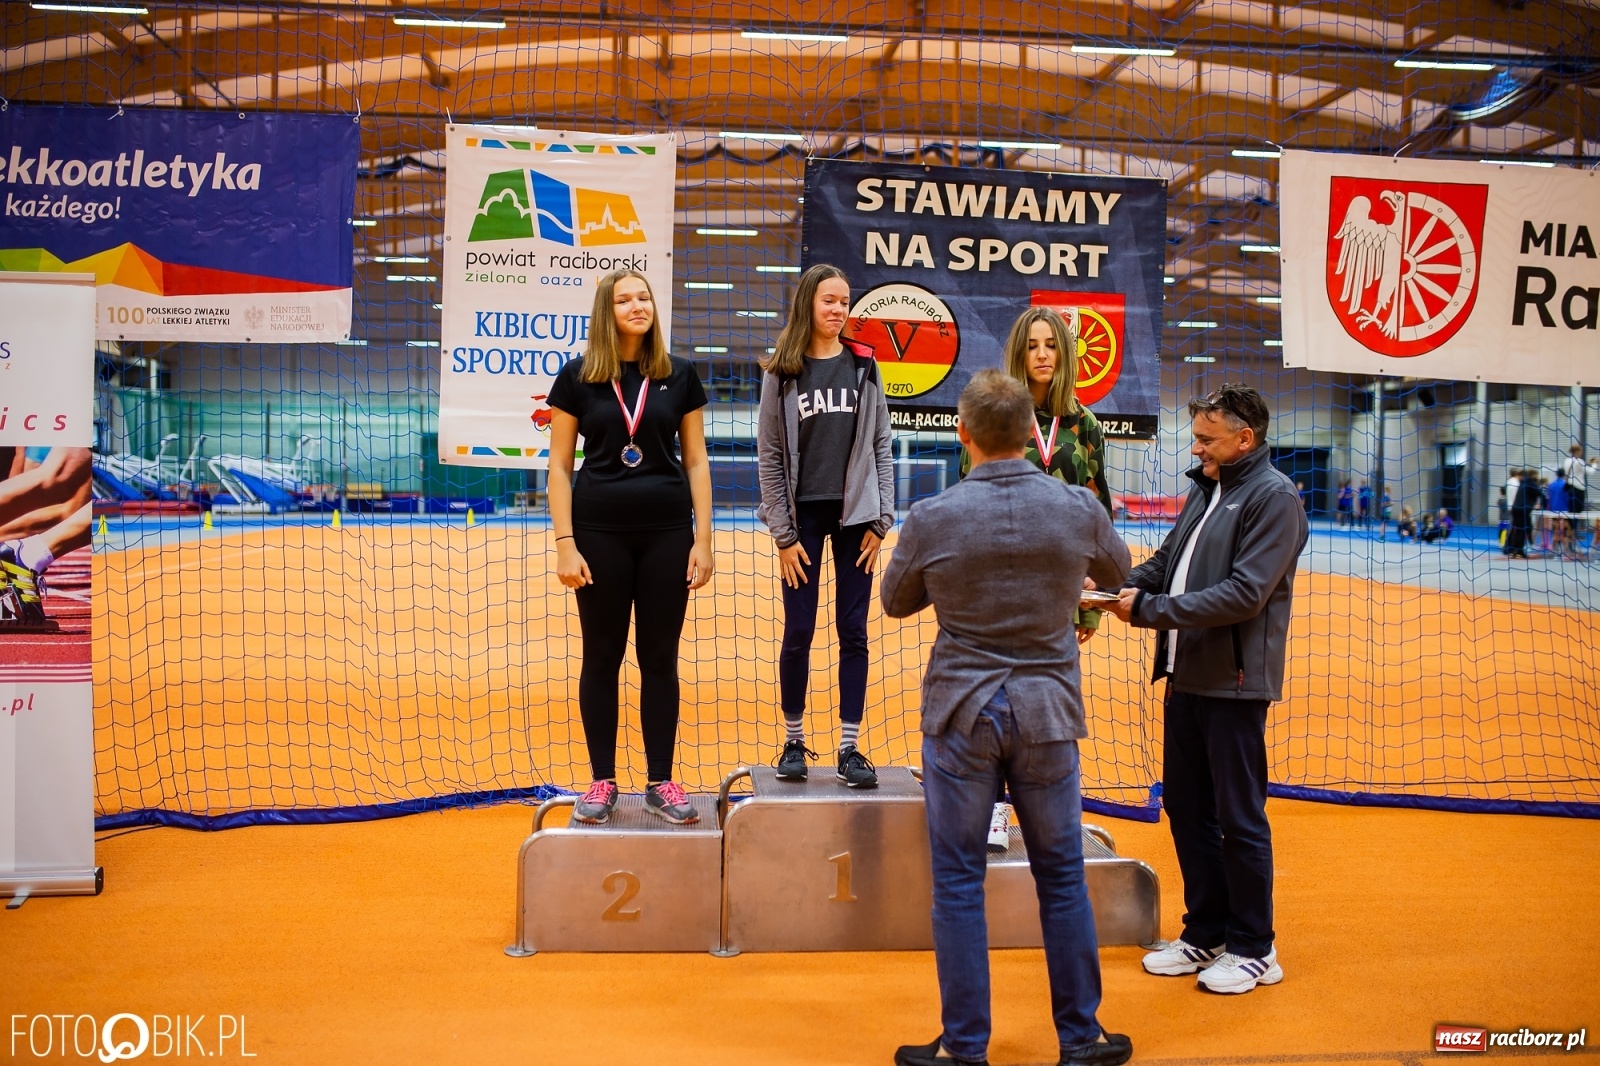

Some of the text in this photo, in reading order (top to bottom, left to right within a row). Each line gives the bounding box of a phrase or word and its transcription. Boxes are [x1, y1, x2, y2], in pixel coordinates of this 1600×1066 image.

[5, 192, 121, 224] każdego!
[855, 178, 1122, 225] STAWIAMY
[1520, 220, 1600, 259] MIA
[465, 248, 648, 271] powiat raciborski
[865, 231, 1109, 278] NA SPORT
[465, 270, 527, 284] zielona
[540, 276, 583, 287] oaza
[107, 306, 145, 324] 100
[146, 307, 230, 317] POLSKIEGO ZWIĄZKU
[270, 305, 311, 314] MINISTER
[270, 315, 312, 323] EDUKACJI
[852, 295, 950, 338] VICTORIA RACIBÓRZ
[146, 317, 230, 326] LAT LEKKIEJ ATLETYKI
[270, 323, 325, 331] NARODOWEJ
[881, 320, 922, 362] V
[886, 382, 914, 395] 1970
[827, 851, 858, 903] 1
[601, 869, 641, 922] 2
